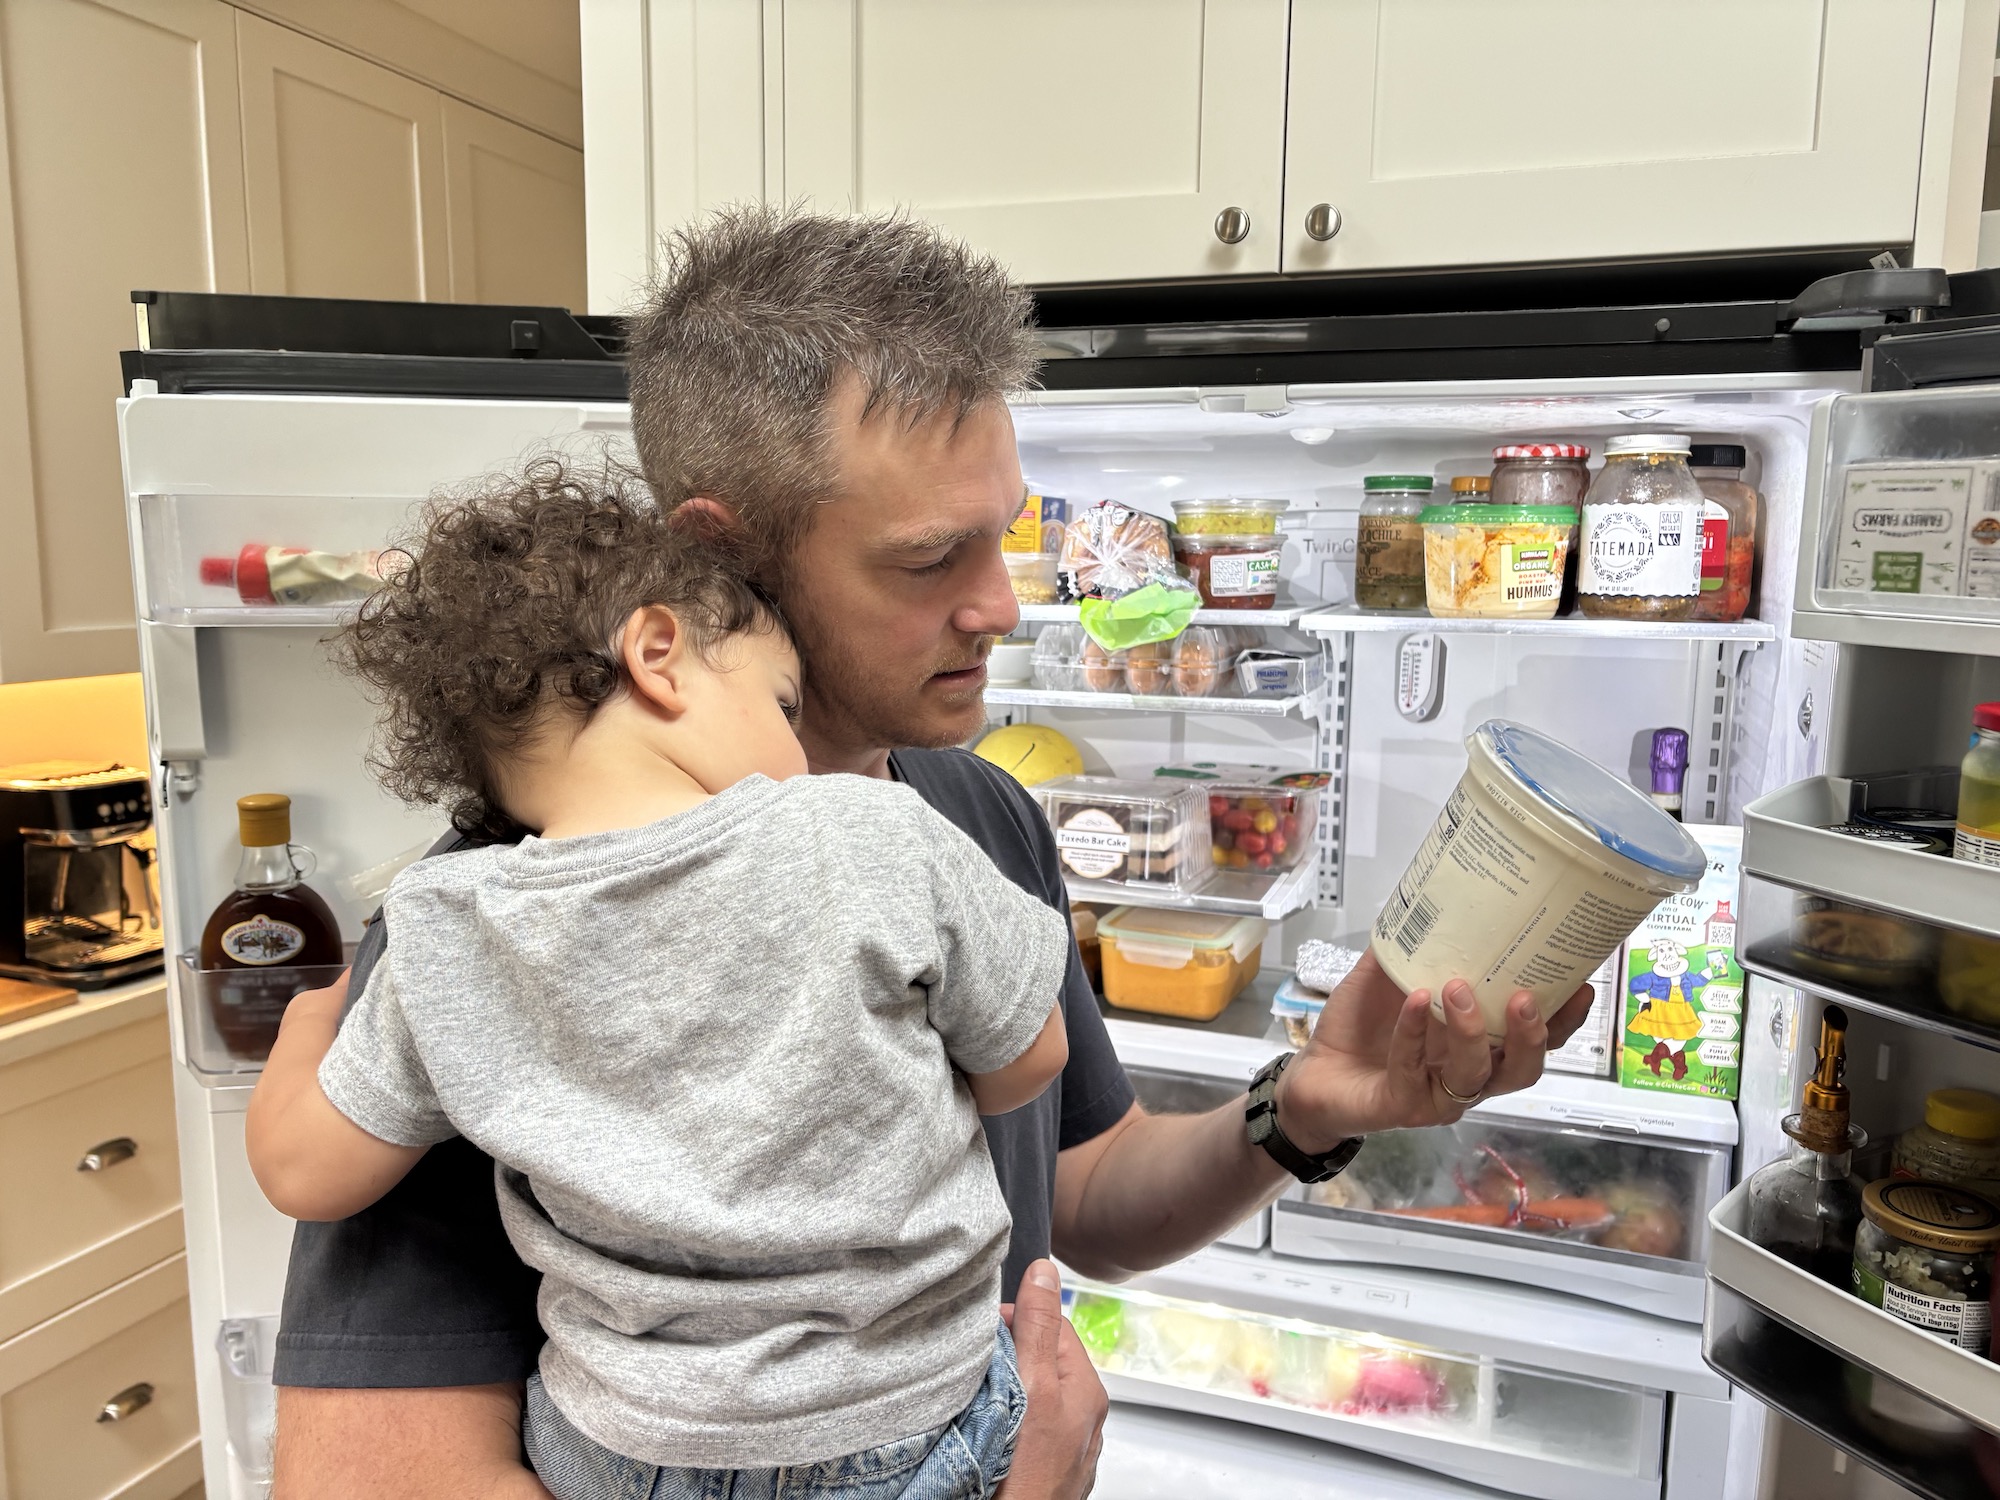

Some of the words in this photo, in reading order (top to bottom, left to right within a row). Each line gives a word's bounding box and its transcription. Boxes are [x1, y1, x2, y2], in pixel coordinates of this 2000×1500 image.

[1662, 513, 1680, 524] SALSA
[1862, 514, 1900, 527] FARMS
[1902, 514, 1943, 527] FAMILY
[1372, 530, 1402, 540] CHILE
[1590, 541, 1654, 556] TATEMADA
[1248, 561, 1269, 571] CASA
[1514, 561, 1550, 571] ORGANIC
[1507, 584, 1553, 600] HUMMUS
[1256, 670, 1288, 678] PHILADELPHIA
[1485, 783, 1509, 806] PROTEIN
[1509, 806, 1526, 822] RICH
[1061, 834, 1090, 844] Tuxedo
[1092, 837, 1104, 845] Bar
[1106, 838, 1126, 848] Cake
[1477, 825, 1486, 833] and
[1484, 832, 1497, 844] active
[1476, 861, 1486, 871] New
[1498, 880, 1507, 889] NY
[1519, 875, 1529, 885] and
[1603, 871, 1635, 888] BILLIONS
[1584, 890, 1599, 900] Once
[1587, 900, 1597, 908] old
[1564, 923, 1574, 931] the
[1492, 964, 1501, 976] TEAR
[1507, 943, 1518, 957] LABEL
[1517, 934, 1526, 944] AND
[1525, 916, 1540, 935] RECYCLE
[1539, 906, 1548, 916] CUP
[1545, 940, 1561, 951] yogurt
[1704, 1054, 1730, 1062] SURPRISES
[1634, 1078, 1654, 1087] Follow
[1656, 1081, 1696, 1092] @CloTheCow
[1550, 1105, 1568, 1114] Fruits
[1640, 1116, 1674, 1127] Vegetables
[1905, 1228, 1933, 1242] Shake
[1938, 1236, 1962, 1248] Until
[1888, 1286, 1930, 1308] Nutrition
[1933, 1301, 1962, 1313] Facts
[1887, 1298, 1900, 1306] About
[1900, 1302, 1906, 1310] 32
[1906, 1304, 1928, 1316] Servings
[1937, 1314, 1960, 1322] Container
[1886, 1304, 1907, 1318] Serving
[1908, 1314, 1920, 1322] size
[1928, 1318, 1942, 1327] tbsp
[1943, 1321, 1960, 1330] (15g)
